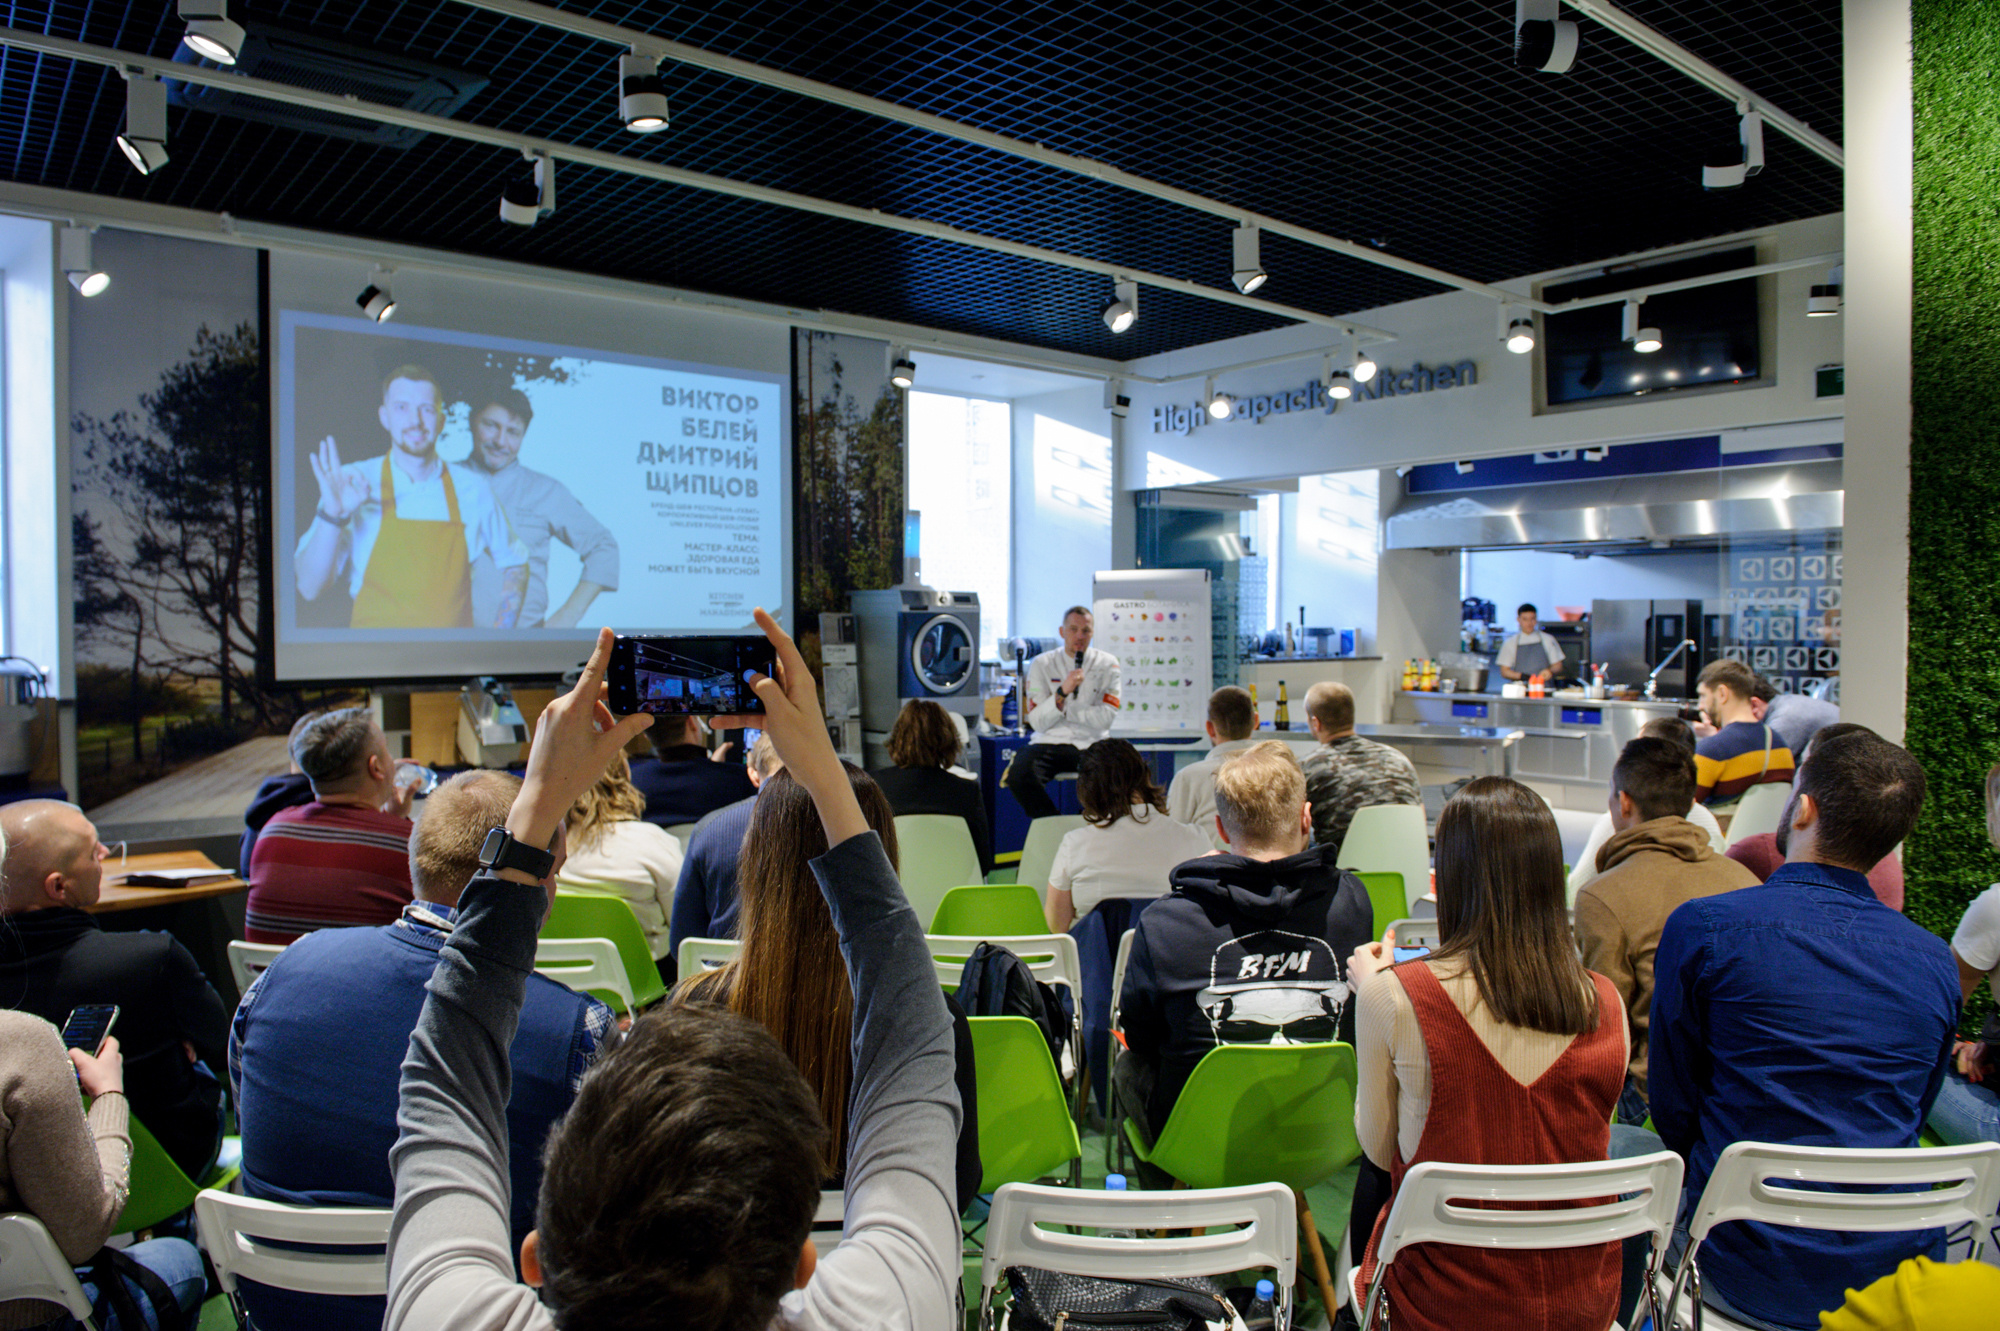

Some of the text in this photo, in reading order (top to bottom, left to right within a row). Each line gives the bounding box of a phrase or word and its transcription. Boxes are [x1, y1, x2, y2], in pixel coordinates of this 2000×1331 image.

[662, 386, 758, 414] ВИКТОР
[682, 417, 757, 443] БЕЛЕЙ
[1152, 402, 1207, 436] High
[637, 441, 757, 470] ДМИТРИЙ
[646, 471, 758, 499] ЩИПЦОВ
[648, 564, 760, 576] МОЖЕТ БЫТЬ ВКУСНОЙ
[687, 553, 760, 565] ЗДОРОВАЯ ЕДА
[1113, 601, 1146, 609] GASTRO
[1237, 949, 1312, 981] BFM
